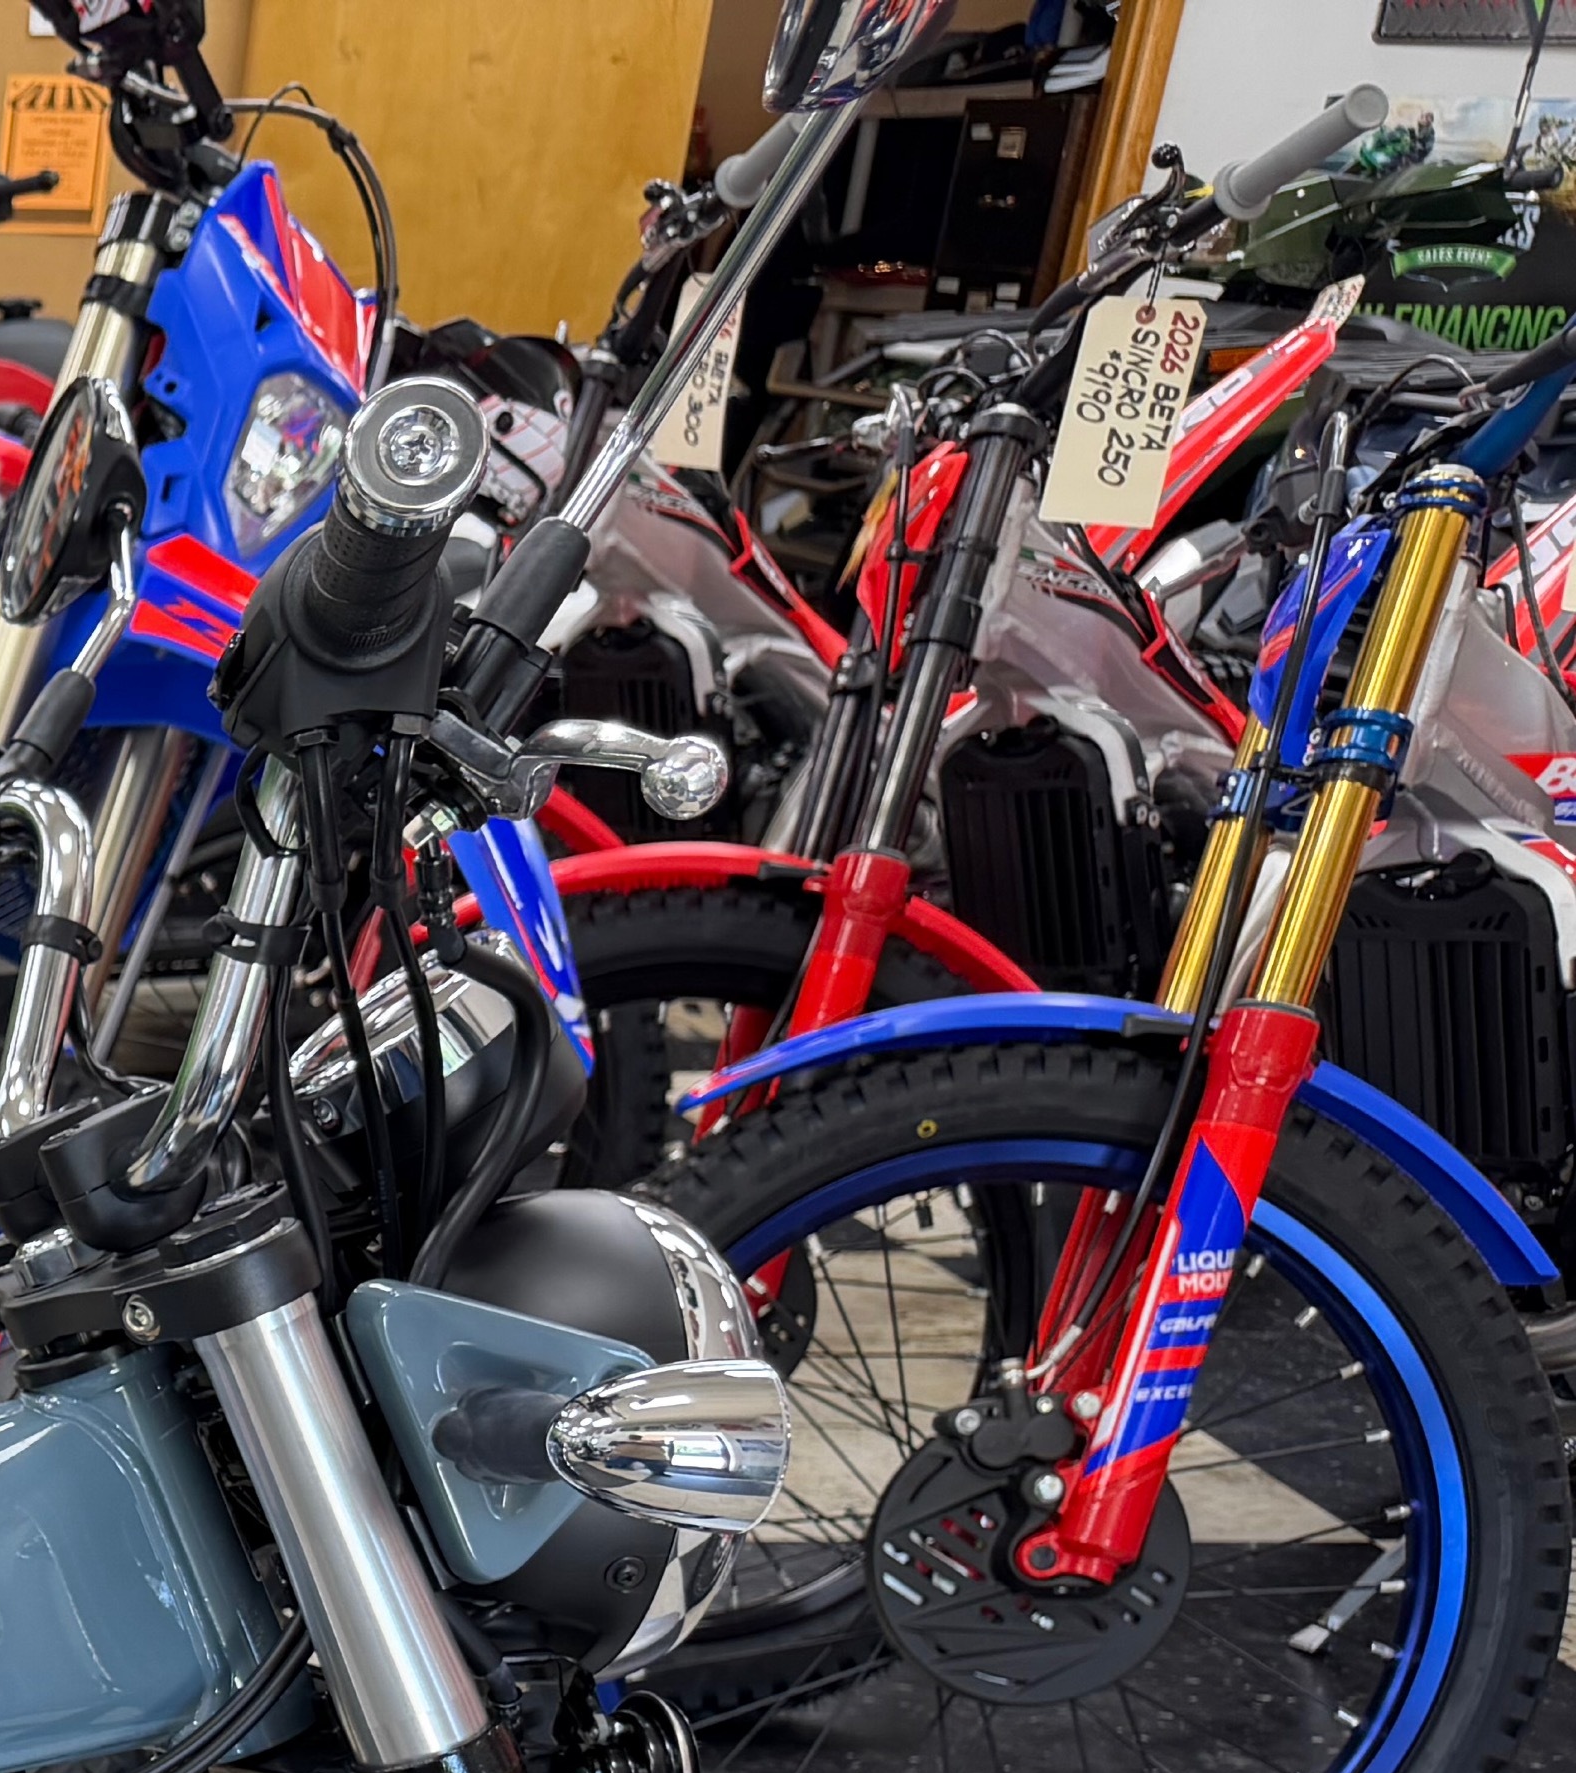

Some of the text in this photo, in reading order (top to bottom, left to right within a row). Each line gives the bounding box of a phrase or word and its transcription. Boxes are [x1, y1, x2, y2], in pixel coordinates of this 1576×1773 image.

[1417, 247, 1493, 264] SALES EVENT
[1139, 310, 1200, 451] 2026 BETA
[1098, 327, 1161, 487] SINCRO 250
[1177, 1249, 1235, 1273] LIQU
[1135, 1383, 1193, 1402] EXCE
